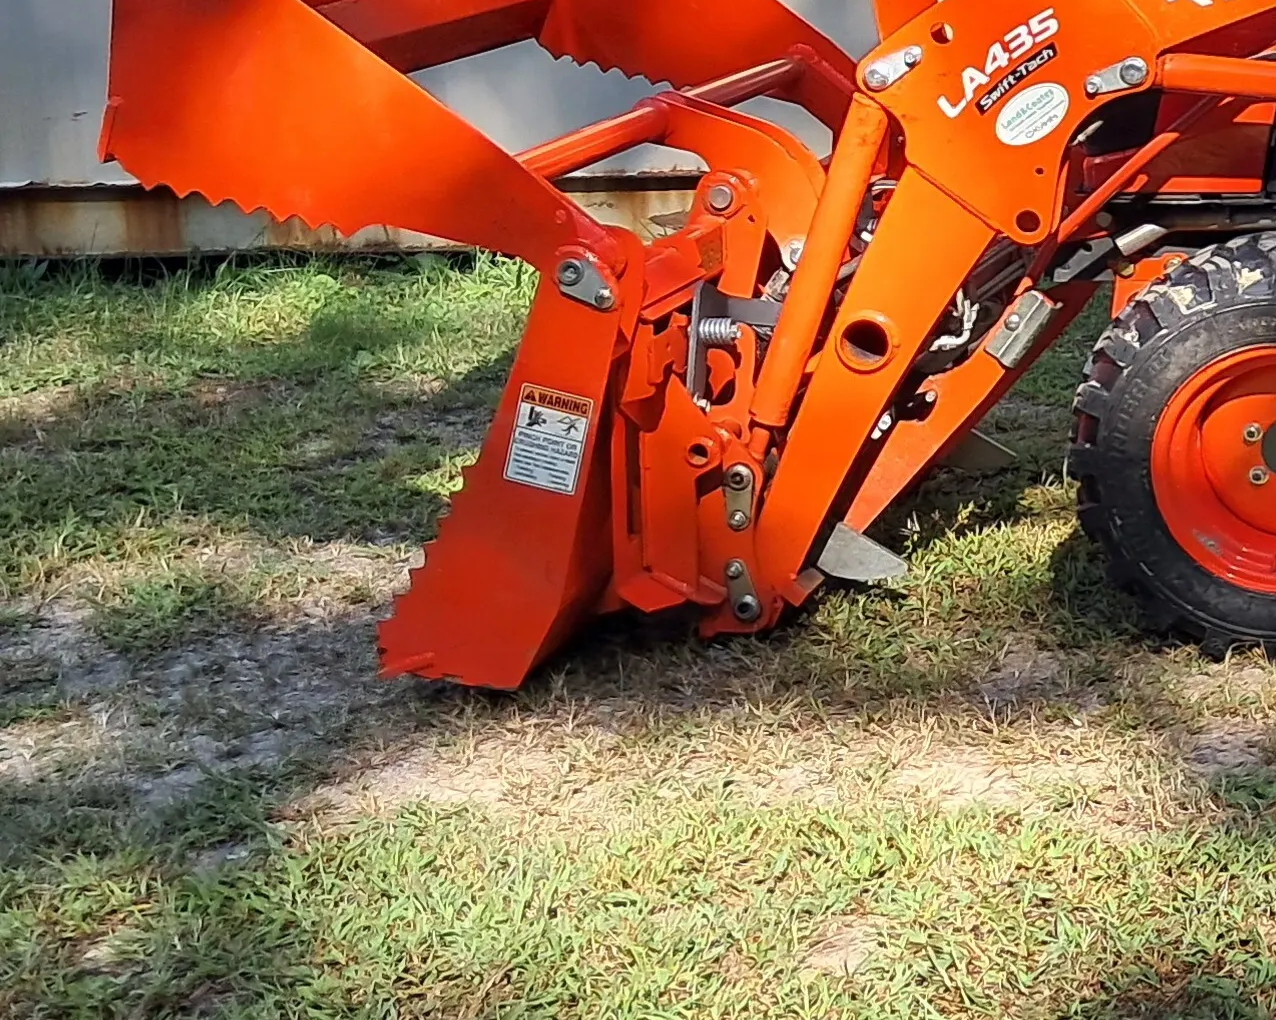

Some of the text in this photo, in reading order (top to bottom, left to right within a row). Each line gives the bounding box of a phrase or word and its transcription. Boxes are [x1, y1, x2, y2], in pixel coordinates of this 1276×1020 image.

[936, 7, 1060, 118] LA435
[979, 48, 1055, 111] Swift-Tach
[537, 390, 588, 416] WARNING
